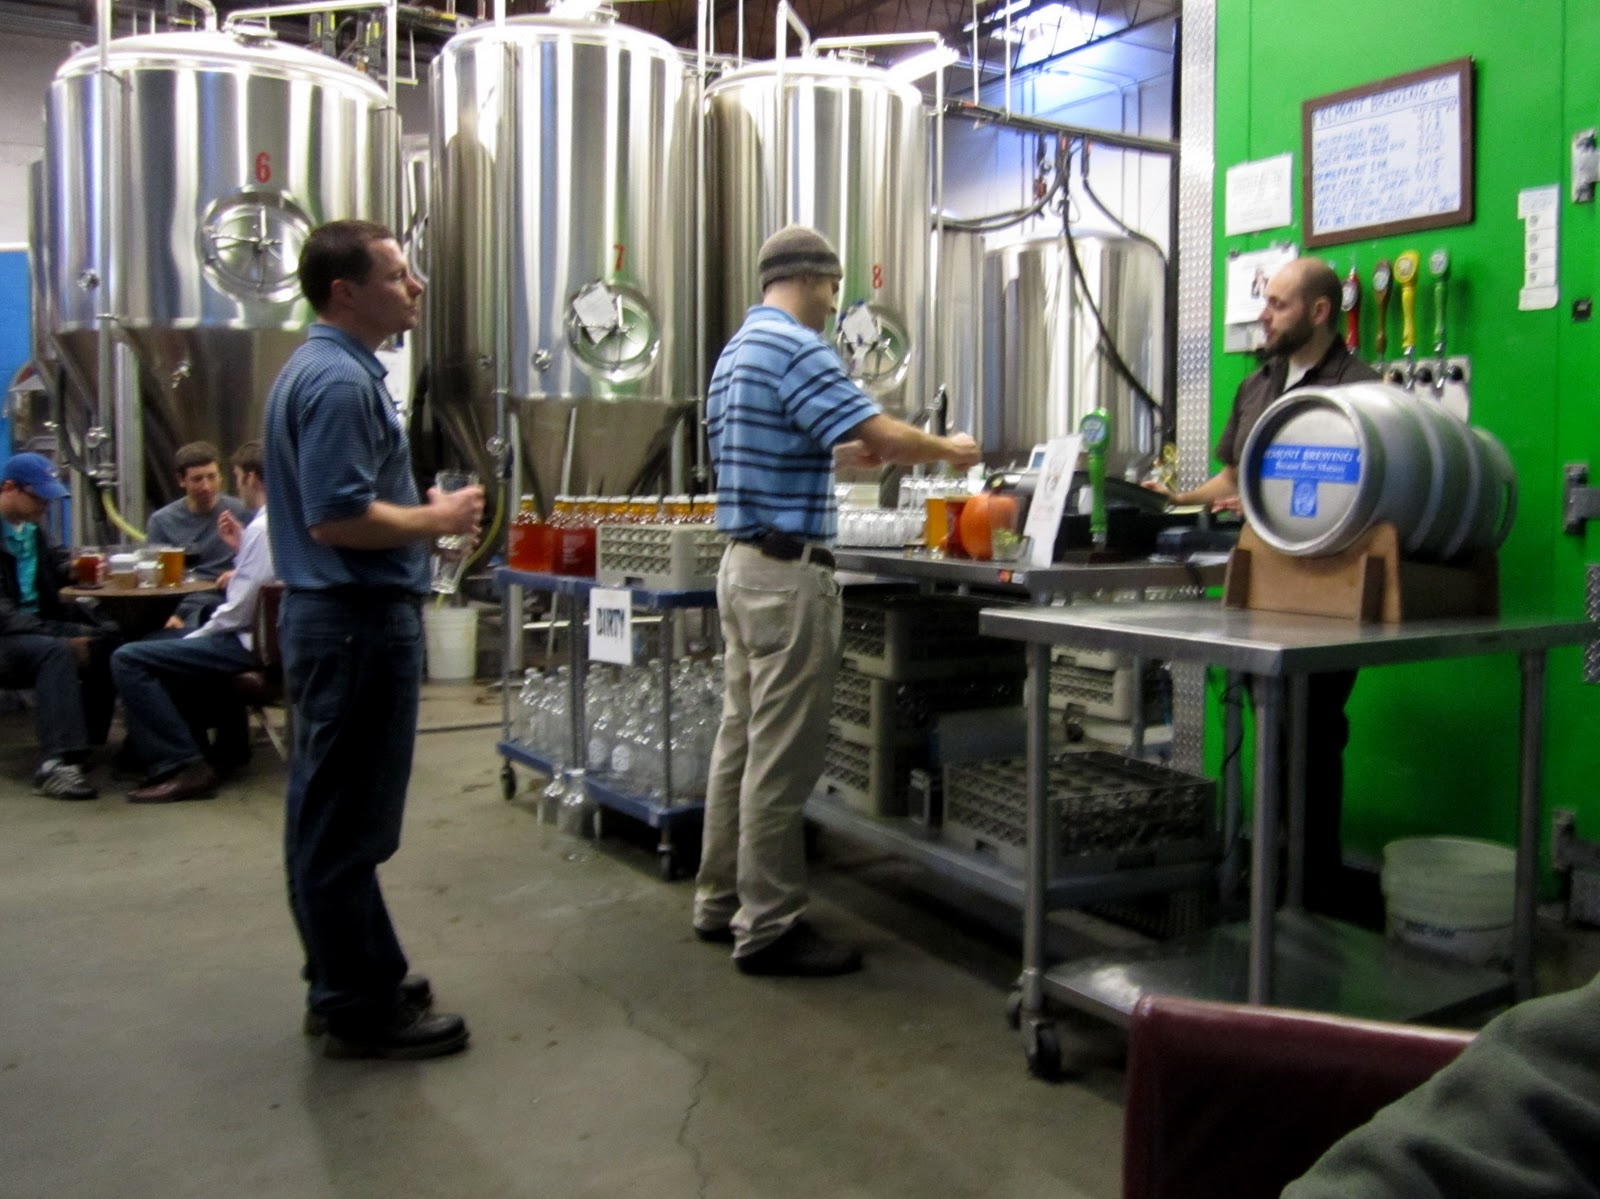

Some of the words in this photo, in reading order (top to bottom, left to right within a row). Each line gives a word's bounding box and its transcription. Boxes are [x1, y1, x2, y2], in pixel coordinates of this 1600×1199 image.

[255, 151, 272, 184] 6
[613, 244, 625, 272] 7
[872, 264, 883, 289] 8
[1264, 449, 1300, 460] EMONT
[1303, 449, 1354, 463] BREWING
[596, 608, 625, 639] DIRTY
